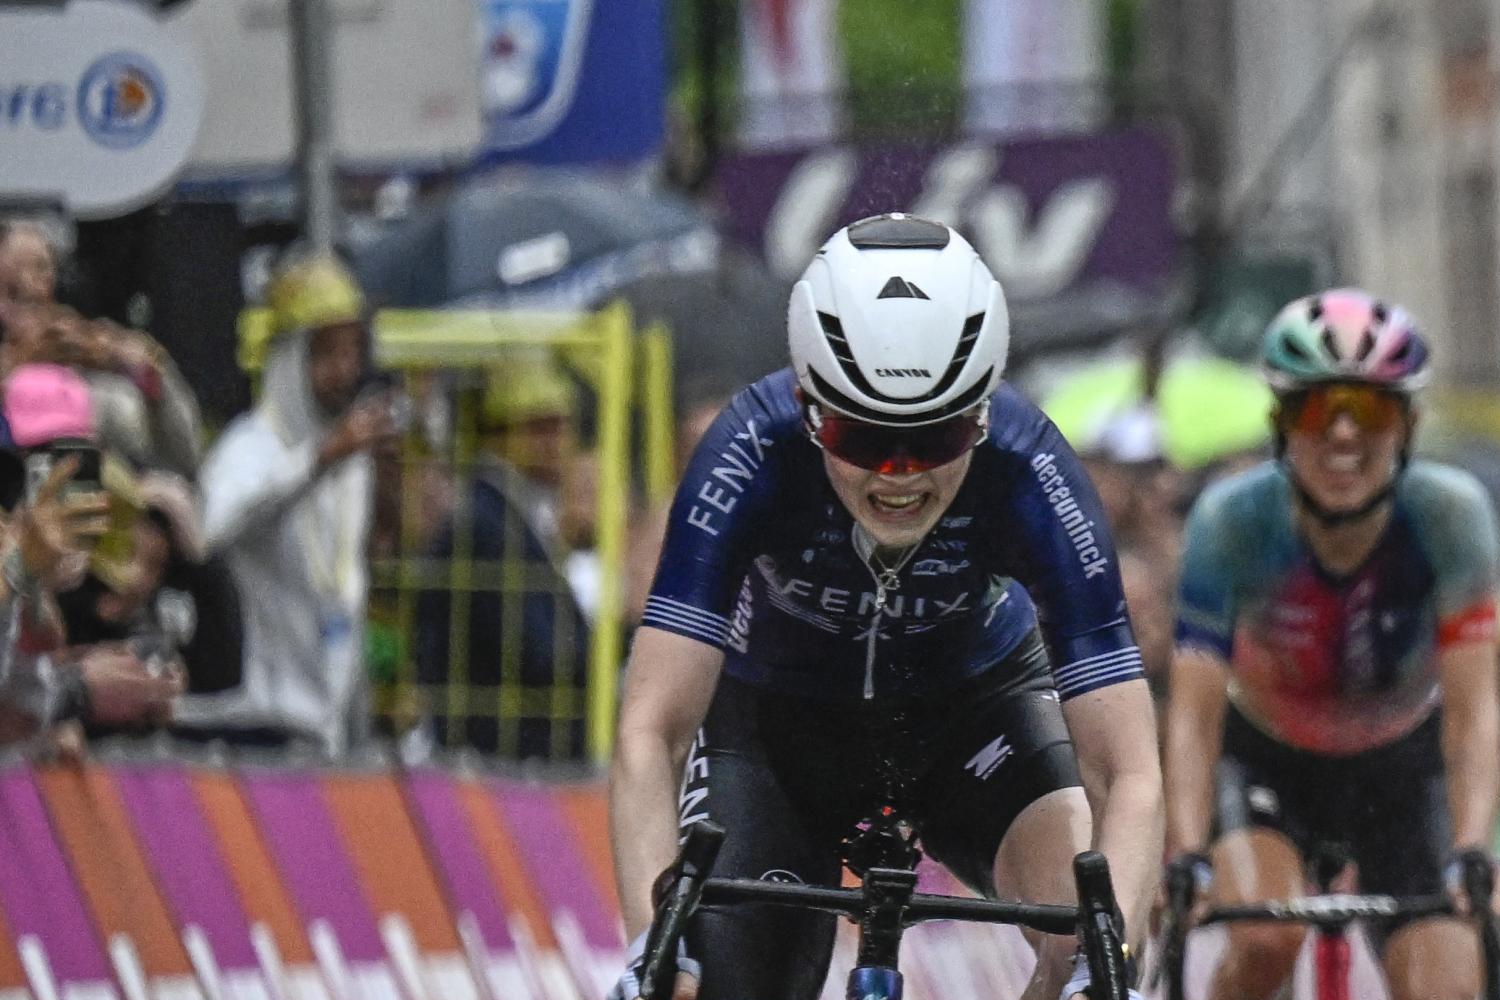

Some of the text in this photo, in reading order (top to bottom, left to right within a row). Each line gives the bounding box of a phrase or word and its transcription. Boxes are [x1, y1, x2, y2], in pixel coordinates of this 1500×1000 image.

[875, 368, 931, 378] CANYON
[687, 419, 775, 537] FENIX
[1029, 452, 1110, 580] deceuninck
[780, 577, 972, 619] FENIX
